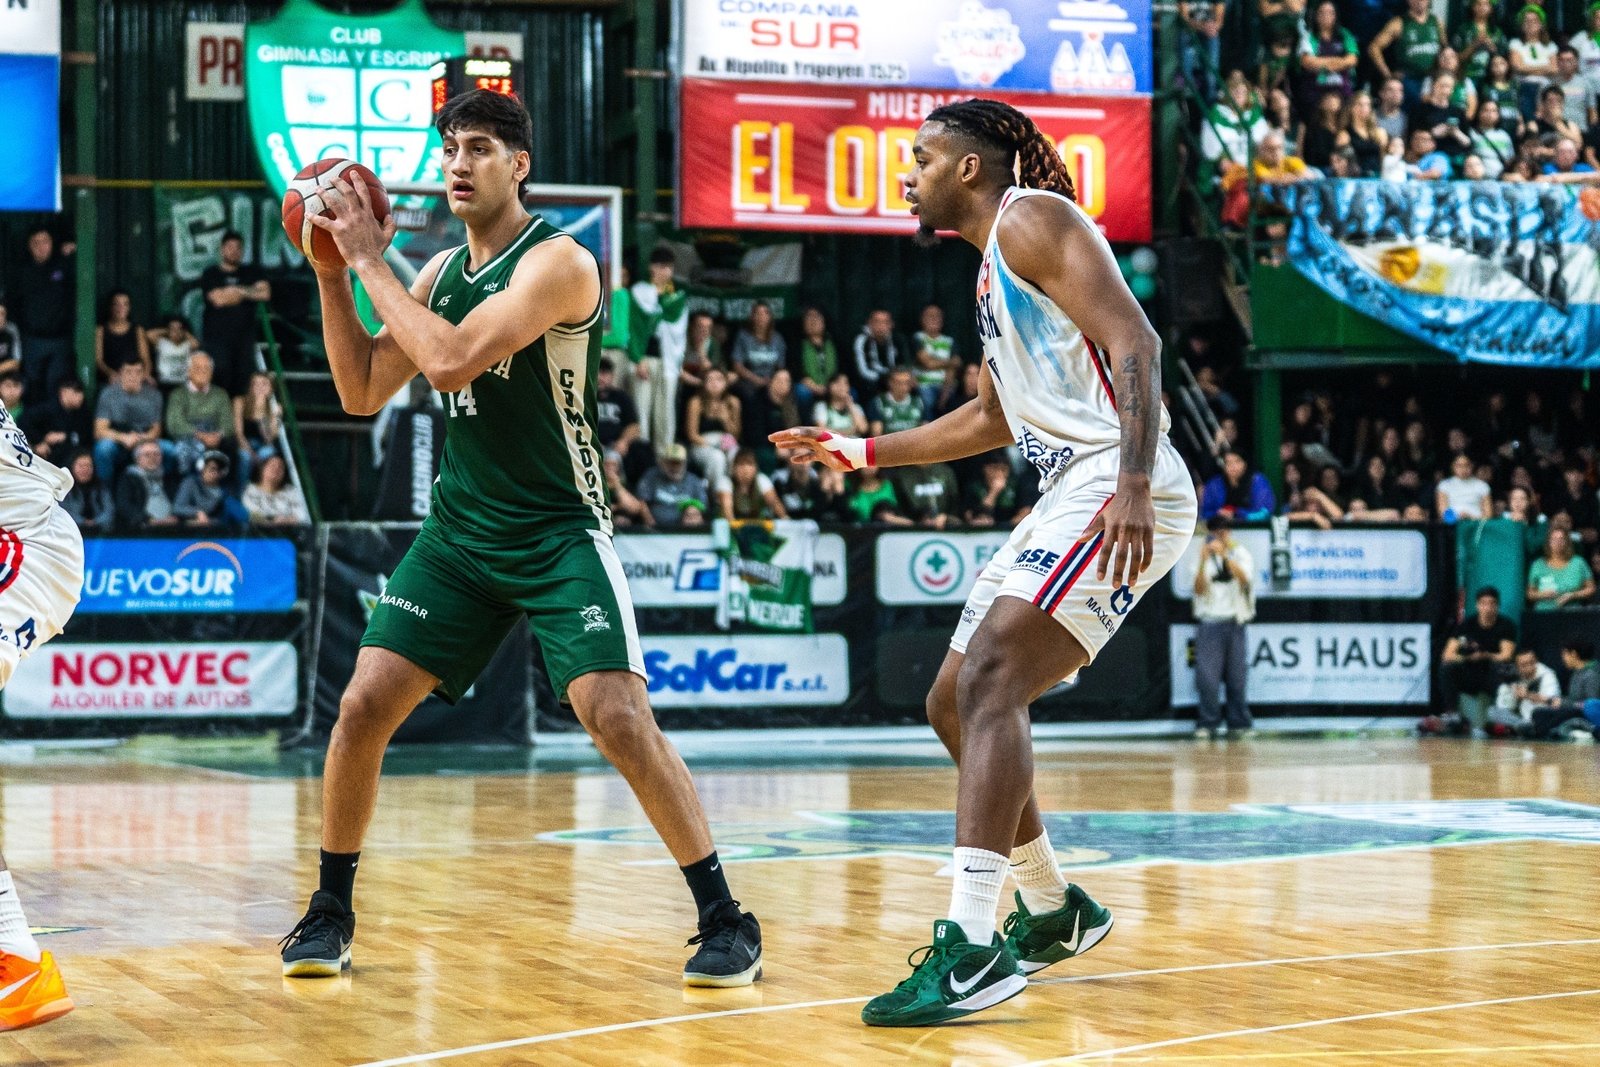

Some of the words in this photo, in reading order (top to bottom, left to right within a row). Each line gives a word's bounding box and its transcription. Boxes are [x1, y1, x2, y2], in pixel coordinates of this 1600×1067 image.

[330, 26, 382, 45] CLUB
[751, 19, 860, 50] SUR
[257, 44, 350, 64] GIMNASIA
[357, 51, 366, 63] Y
[370, 51, 451, 66] ESGRIM
[868, 91, 978, 120] MUEB
[733, 120, 811, 214] EL
[826, 124, 1107, 217] OBO
[448, 382, 478, 418] 14
[85, 568, 236, 597] UEVOSUR
[1315, 636, 1420, 669] HAUS
[52, 652, 250, 687] NORVEC
[52, 692, 146, 710] ALQUILER
[153, 693, 177, 708] DE
[185, 691, 251, 707] AUTOS
